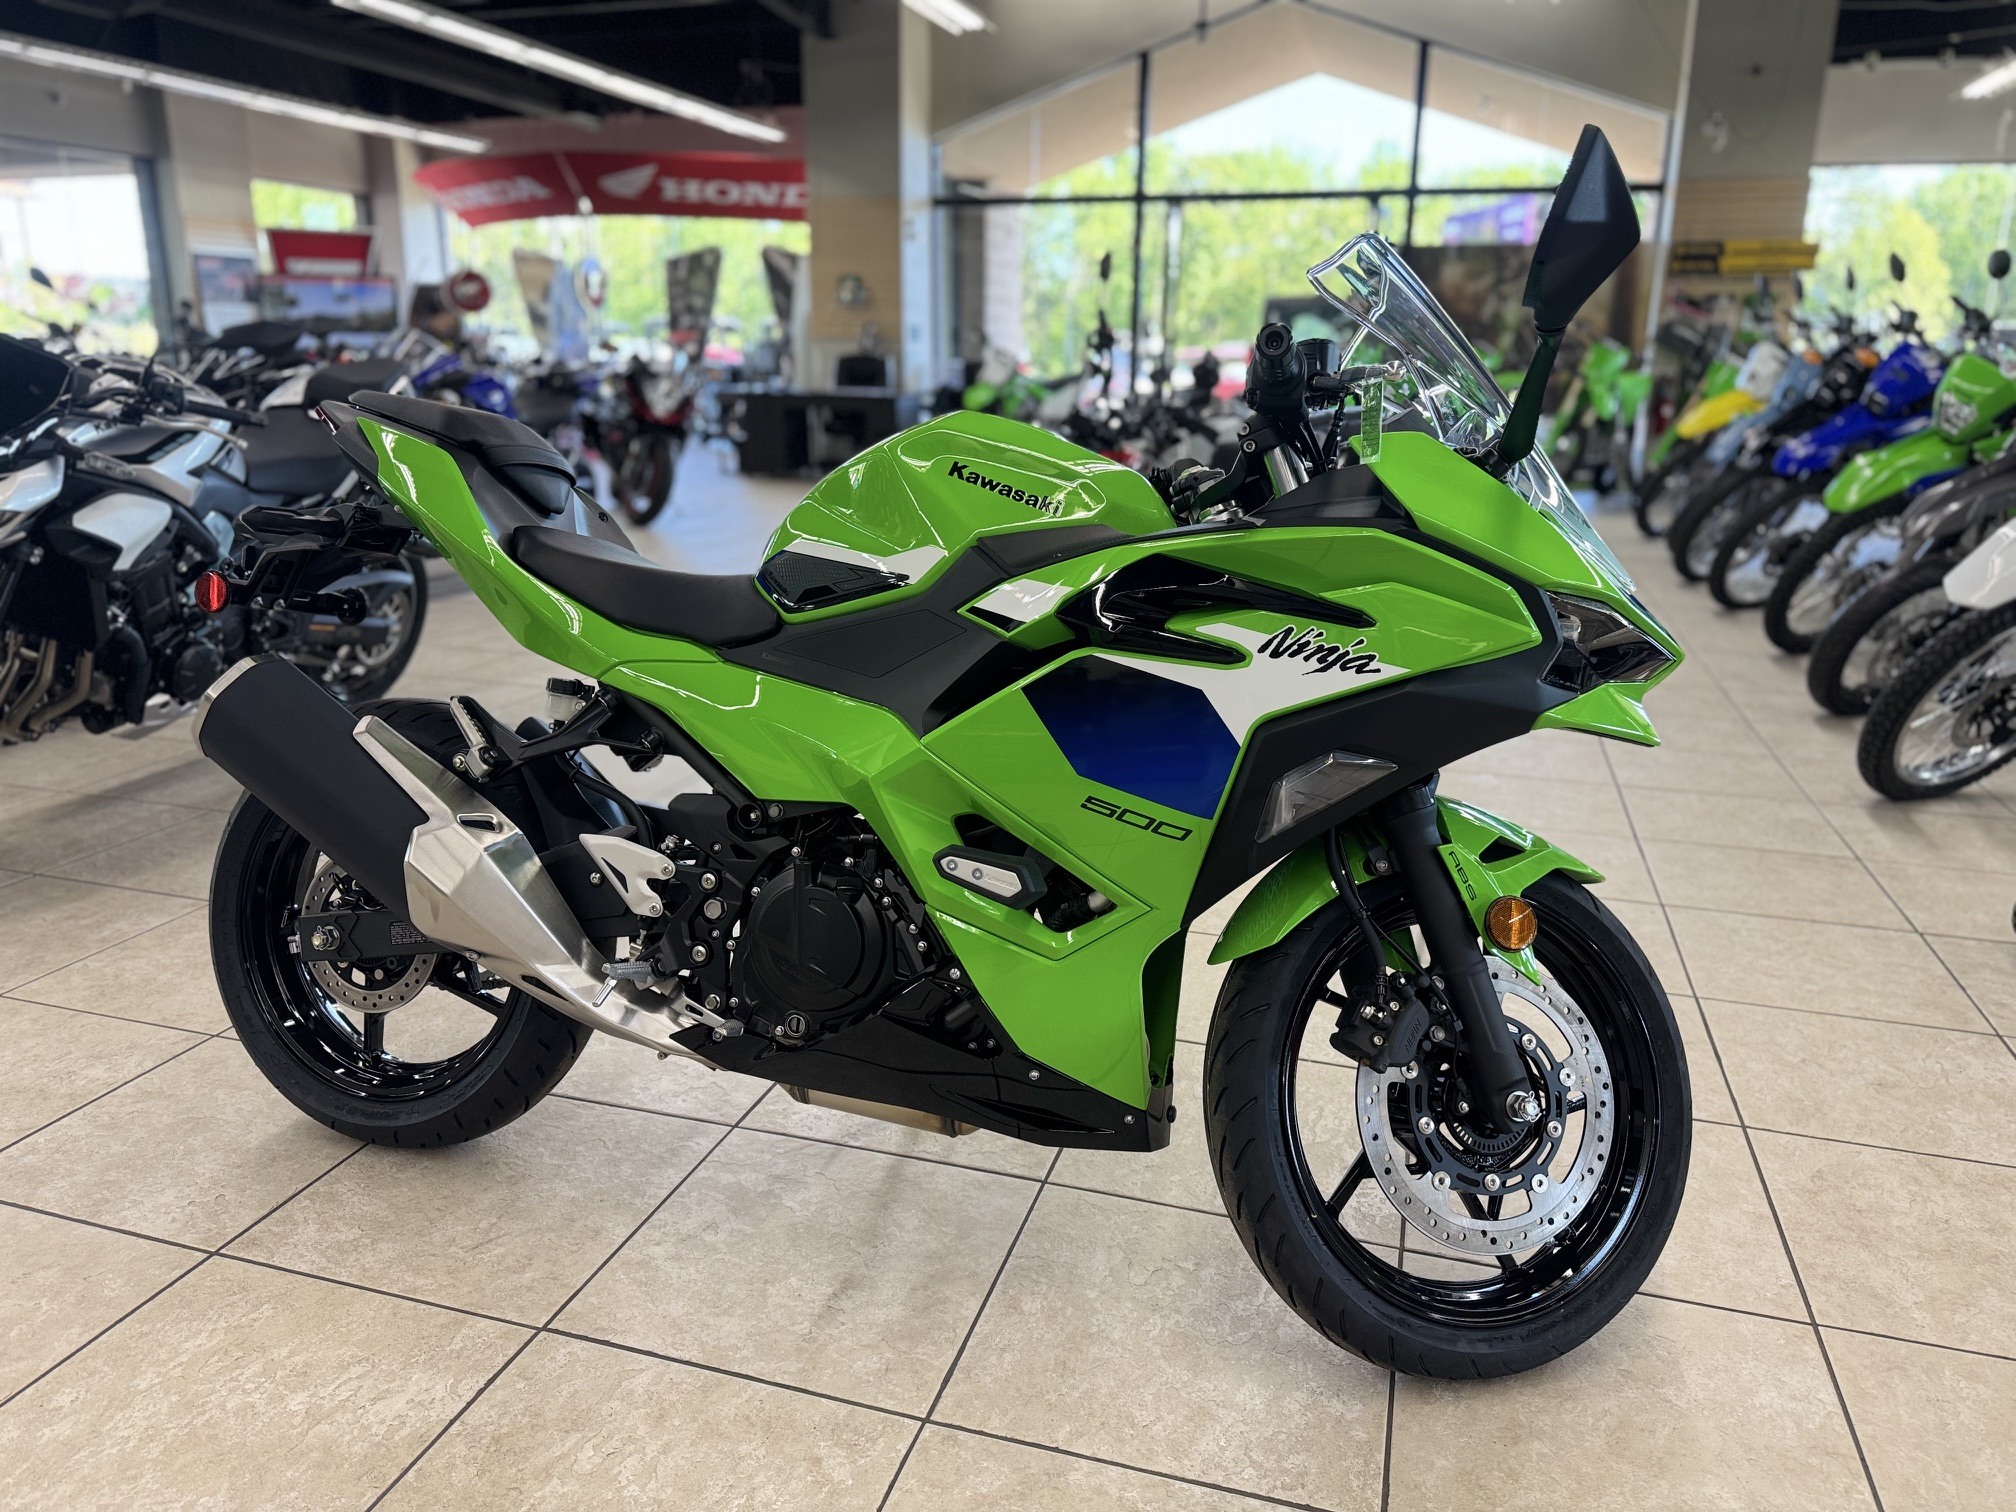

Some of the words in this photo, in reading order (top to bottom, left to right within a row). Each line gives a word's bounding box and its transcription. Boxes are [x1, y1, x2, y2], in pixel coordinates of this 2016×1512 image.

[948, 461, 1065, 517] Kawasaki
[1257, 625, 1381, 676] Ninja
[1080, 795, 1193, 841] 500
[1448, 850, 1477, 901] ABS
